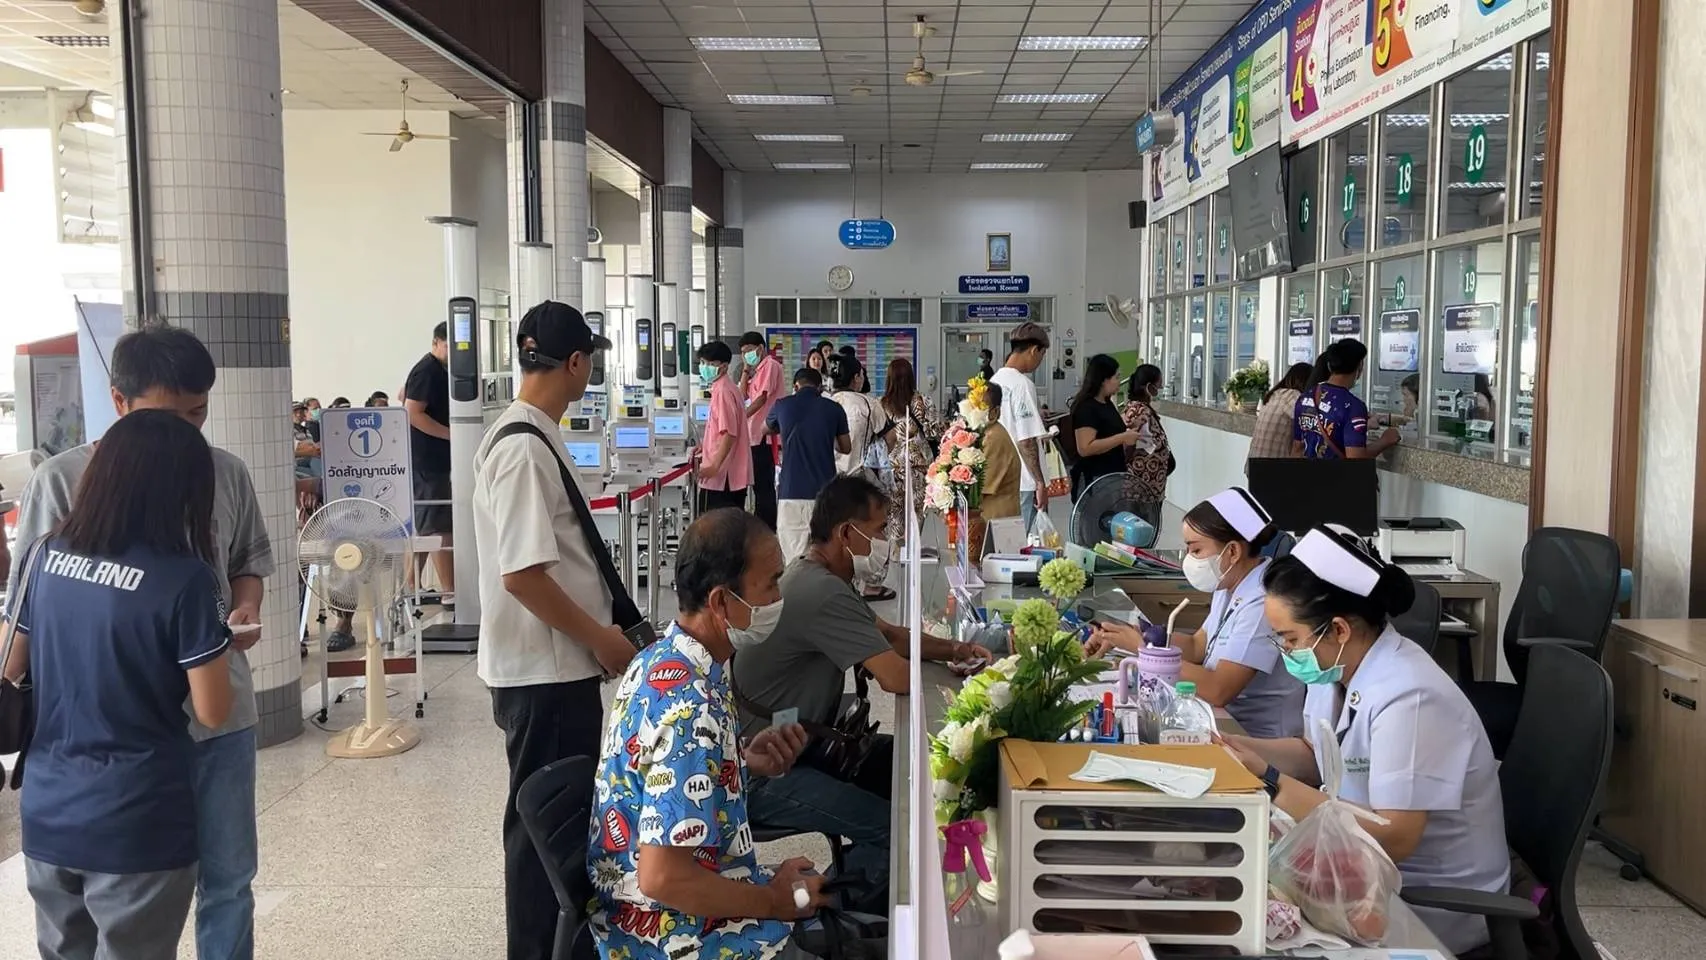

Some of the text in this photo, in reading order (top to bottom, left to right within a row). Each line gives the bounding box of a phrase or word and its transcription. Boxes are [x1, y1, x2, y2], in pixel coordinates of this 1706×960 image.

[1257, 11, 1269, 35] OPD
[1375, 0, 1391, 67] 5
[1495, 22, 1510, 37] Medical
[1527, 8, 1540, 23] Room
[1295, 34, 1311, 53] Station
[1336, 47, 1363, 71] Examination
[1292, 56, 1304, 111] 4
[1235, 101, 1246, 151] 3
[1467, 138, 1485, 172] 19
[1398, 162, 1412, 194] 18
[1343, 184, 1355, 211] 17
[1301, 199, 1310, 224] 16
[1396, 282, 1405, 300] 18
[1465, 272, 1475, 292] 19
[1342, 289, 1349, 305] 17
[354, 413, 375, 429] จุดที่
[358, 430, 370, 455] 1
[328, 464, 406, 478] วัดสัญญาณชีพ
[44, 550, 145, 591] THAILAND
[649, 668, 687, 682] BAM!!!
[688, 779, 710, 794] HA!
[606, 809, 627, 848] BAM!!!
[673, 824, 705, 844] SNAP!
